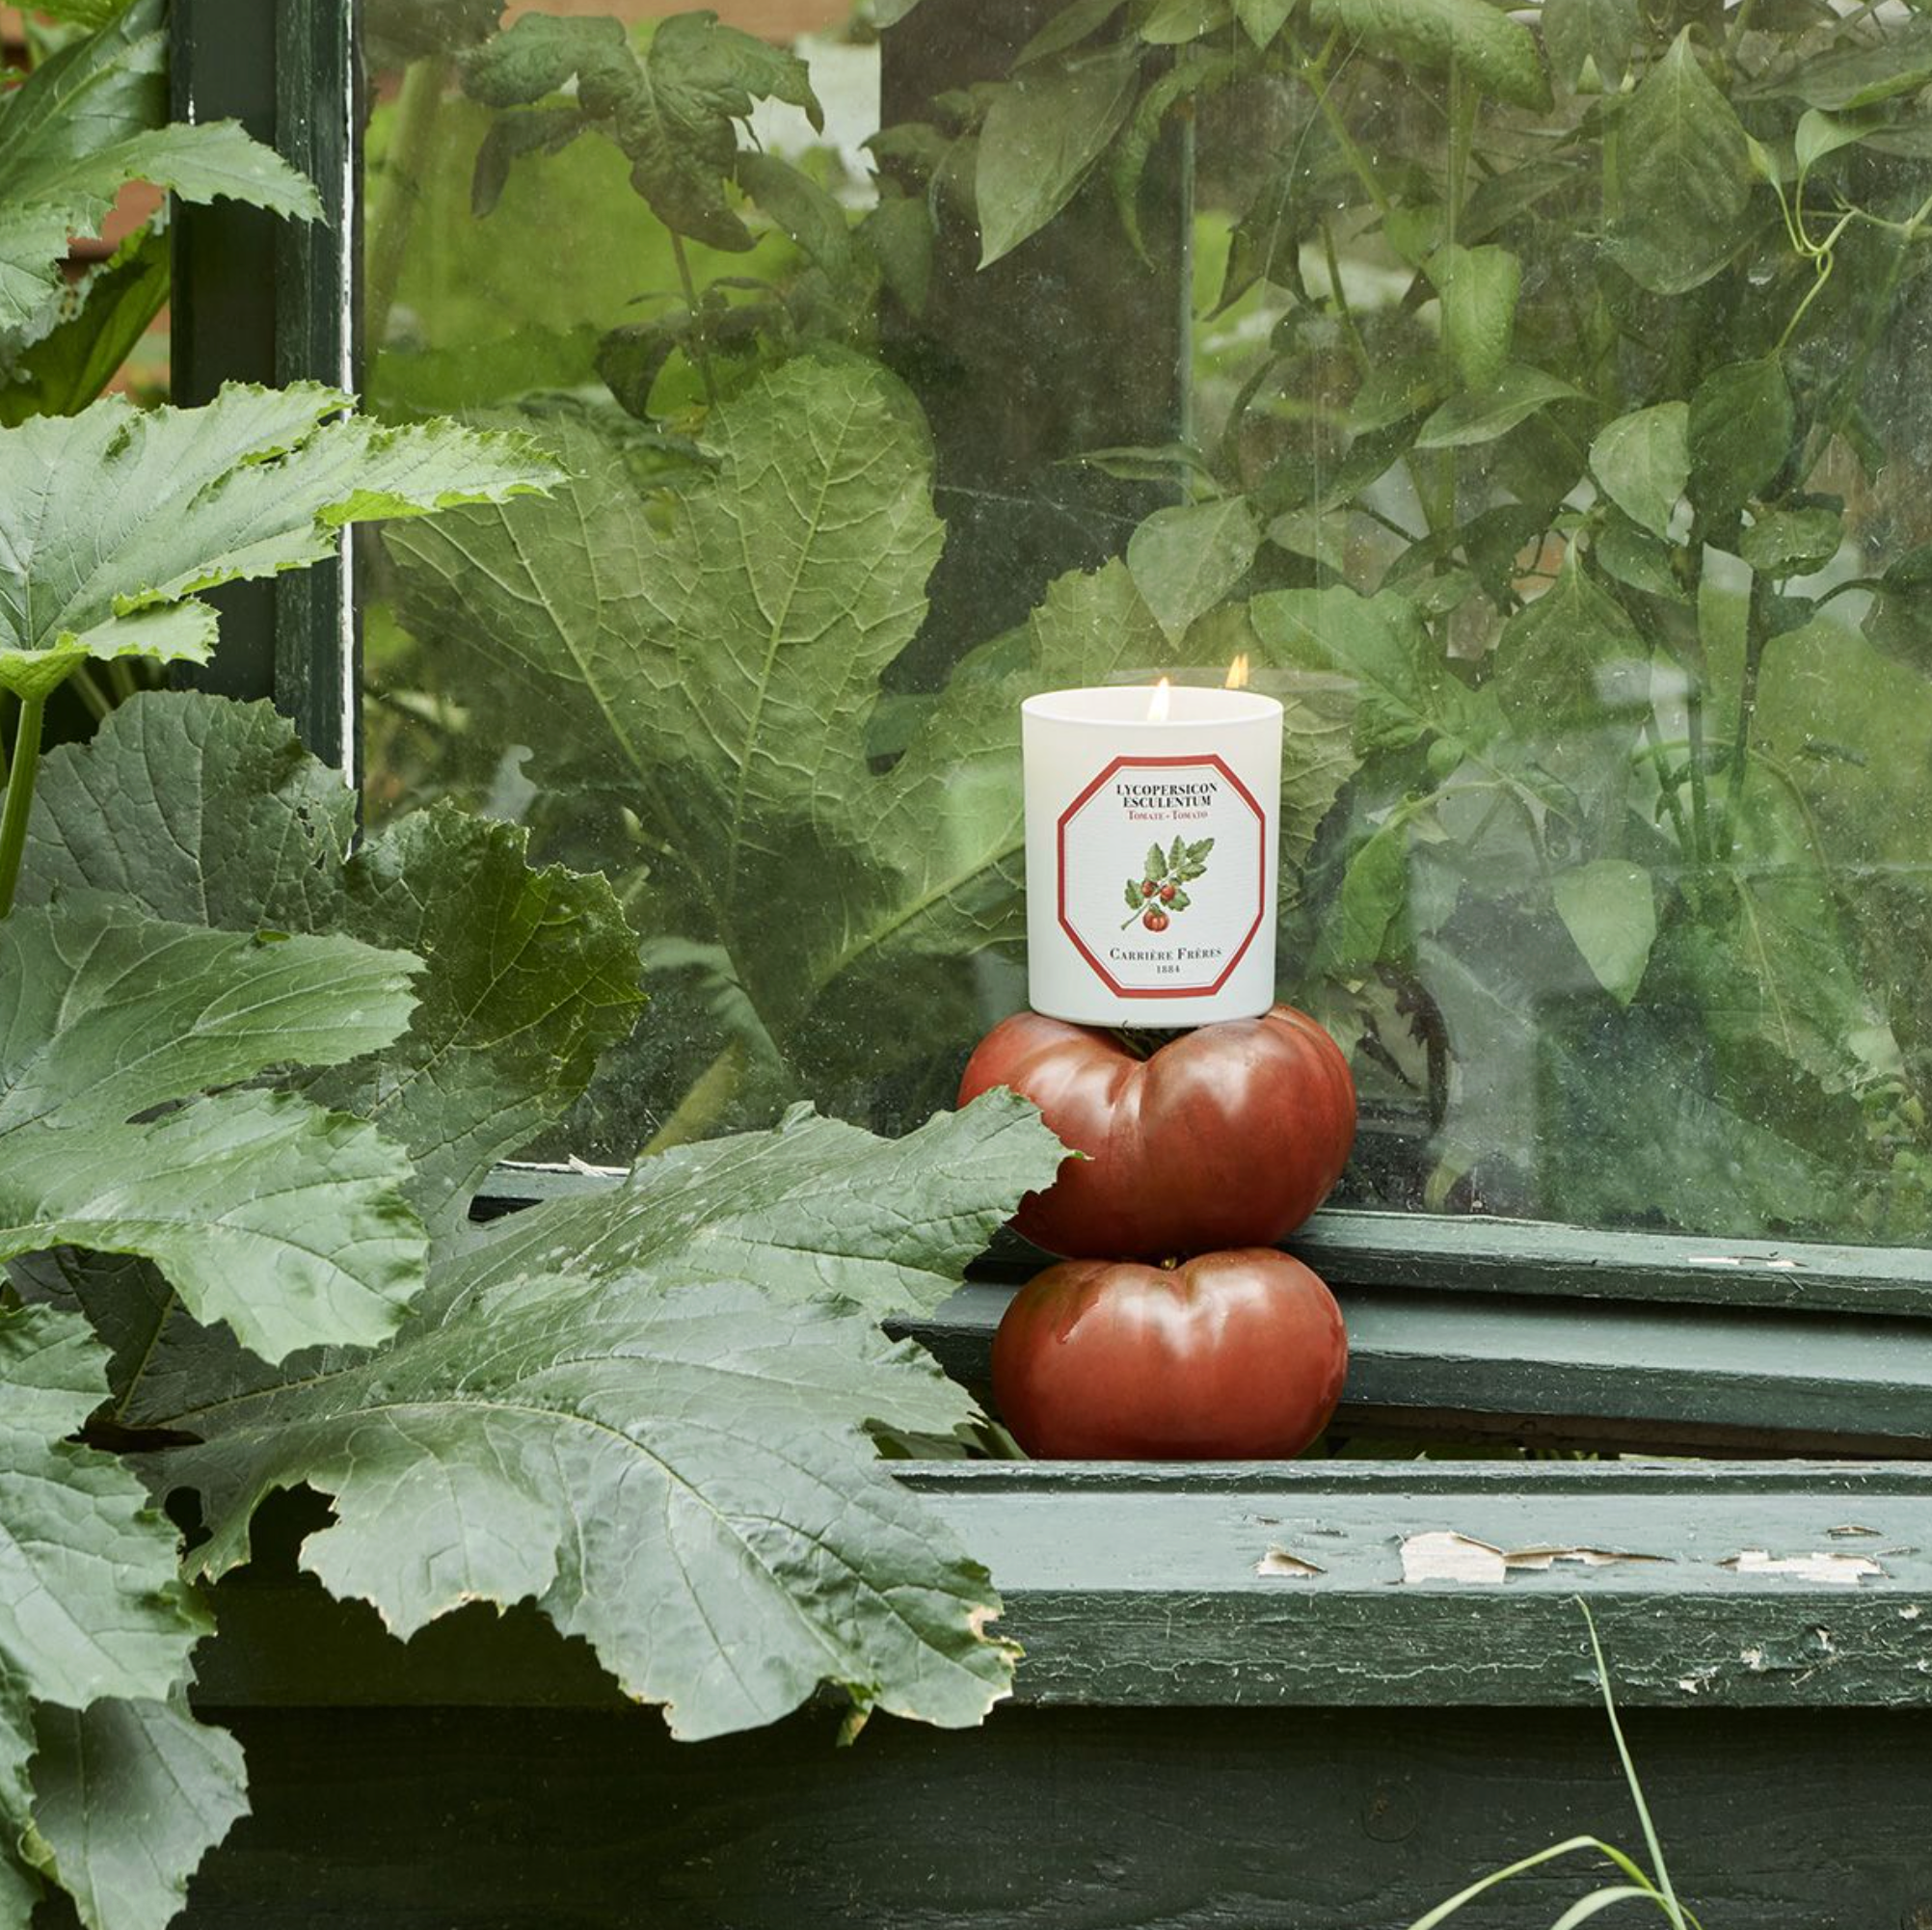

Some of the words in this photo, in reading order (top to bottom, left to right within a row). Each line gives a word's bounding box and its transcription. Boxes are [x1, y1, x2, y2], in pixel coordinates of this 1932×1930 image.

[1116, 782, 1219, 795] LYCOPERSICON
[1123, 795, 1211, 808] ESCULENTUM
[1157, 965, 1180, 974] 1884
